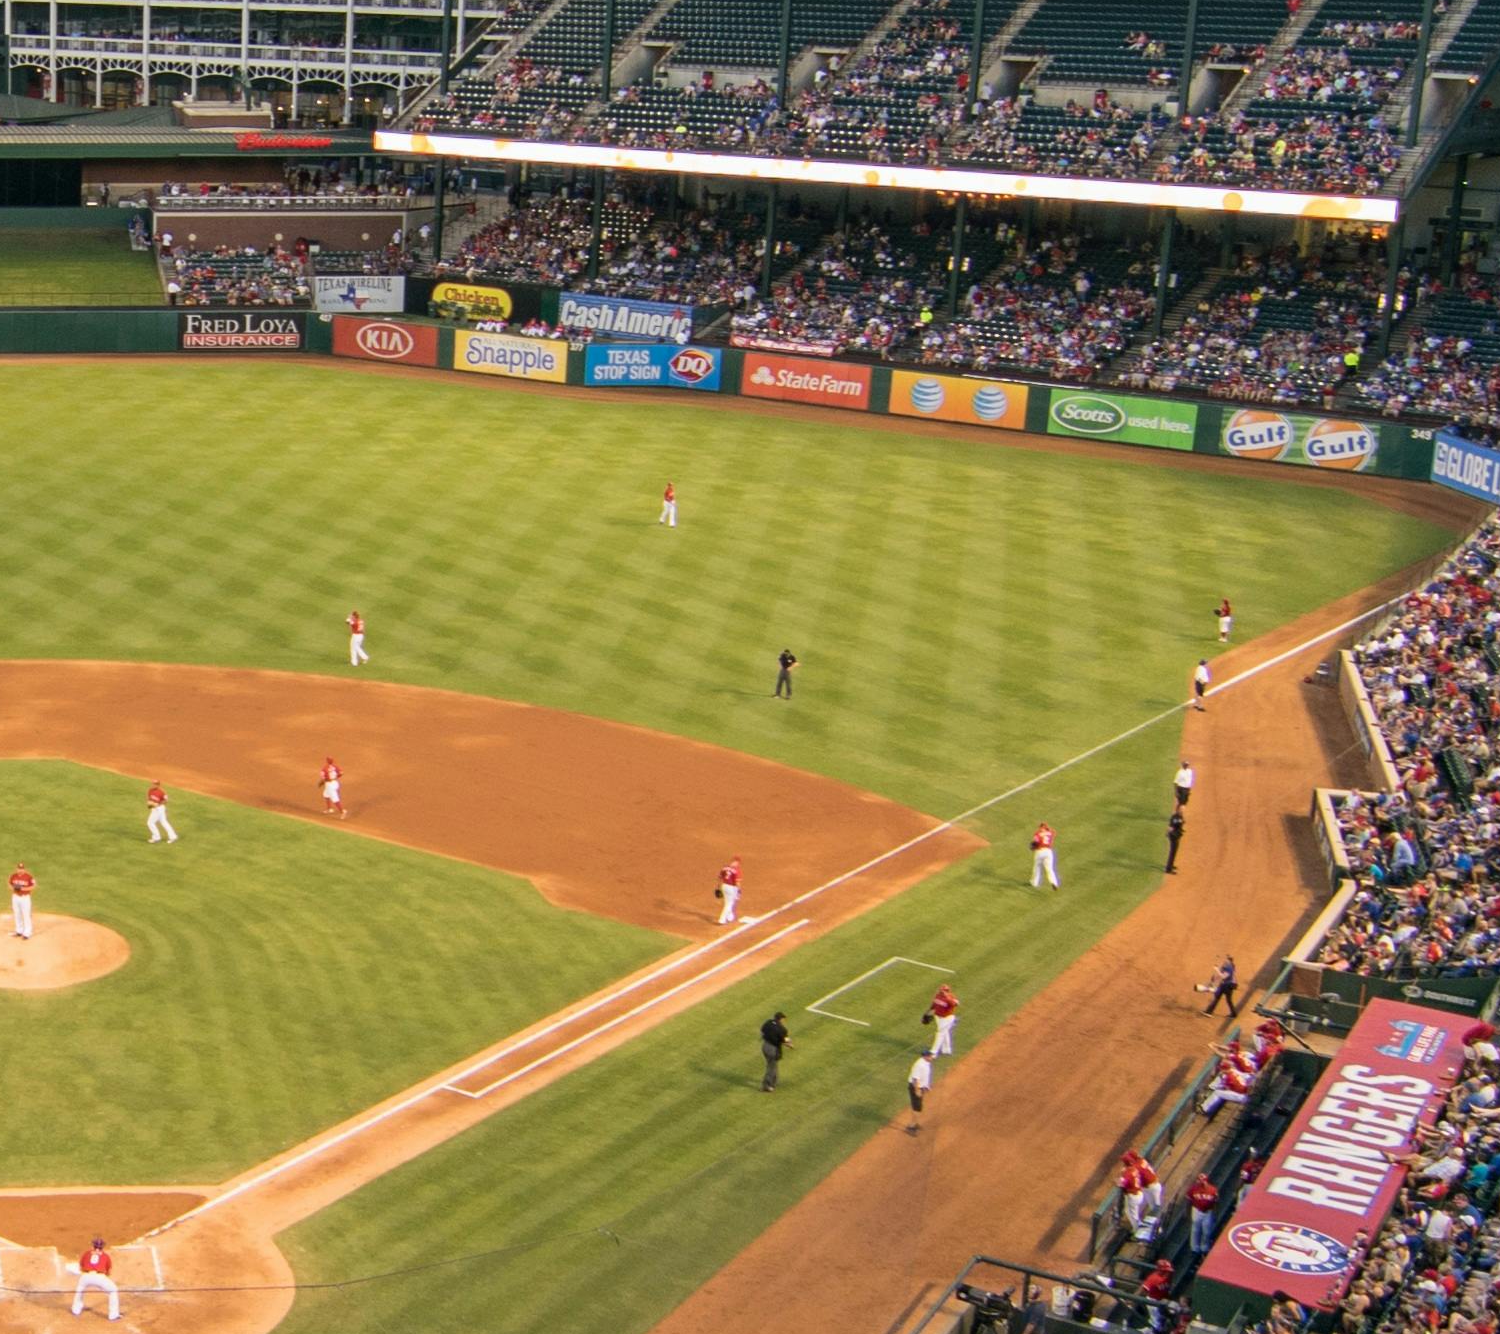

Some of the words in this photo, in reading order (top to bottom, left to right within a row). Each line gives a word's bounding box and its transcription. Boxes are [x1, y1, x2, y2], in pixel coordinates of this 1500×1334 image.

[318, 277, 346, 293] TEXAS
[350, 277, 392, 293] WIRELINE
[445, 288, 499, 306] Chicken
[186, 314, 239, 334] FRED
[245, 314, 298, 334] LOYA
[186, 335, 297, 347] INSURANCE
[366, 329, 403, 351] KIA
[466, 337, 554, 374] Snapple
[608, 350, 650, 364] TEXAS
[677, 355, 705, 376] DQ
[594, 367, 626, 380] STOP
[630, 367, 661, 380] SIGN
[1061, 403, 1114, 425] Scotts
[1128, 415, 1158, 429] used
[1161, 418, 1192, 433] here.
[1228, 427, 1287, 448] Gulf
[1411, 428, 1432, 440] 349
[1308, 435, 1367, 458] Gulf
[1447, 443, 1490, 492] GLOBE
[1266, 1064, 1434, 1216] RANGERS
